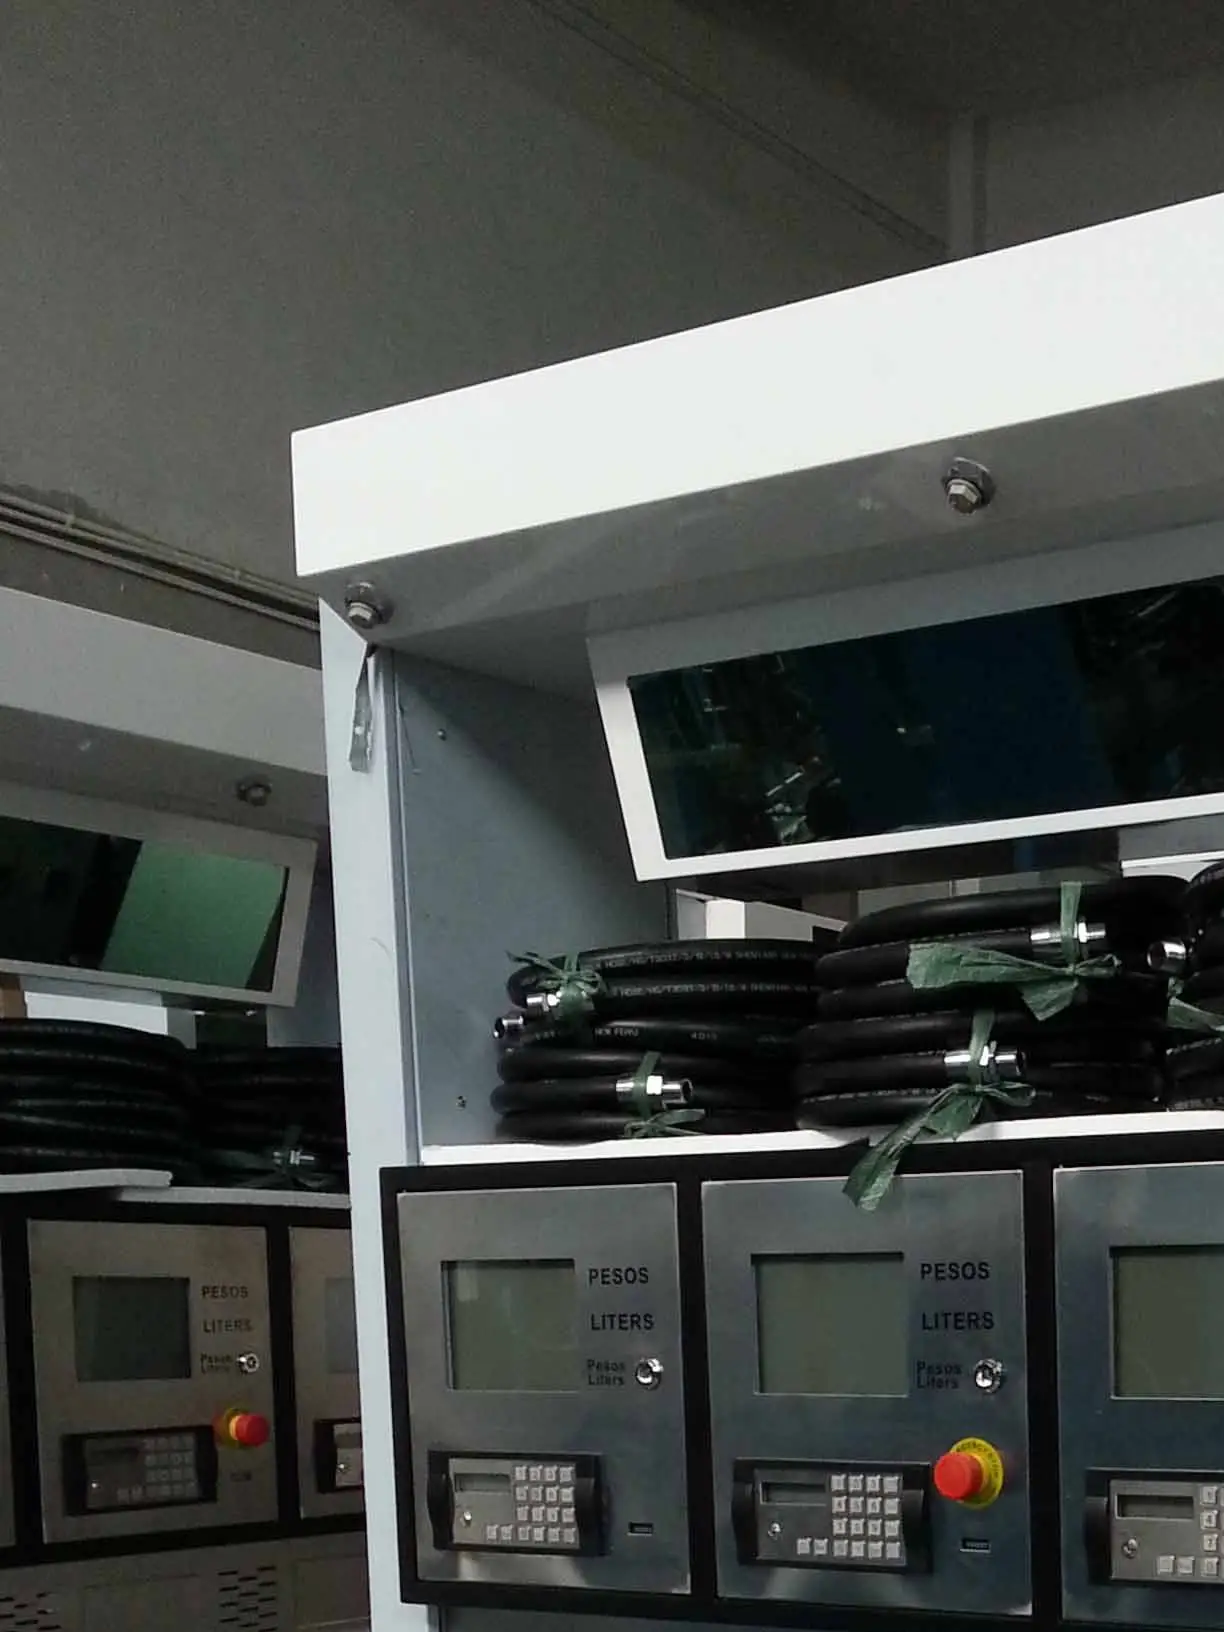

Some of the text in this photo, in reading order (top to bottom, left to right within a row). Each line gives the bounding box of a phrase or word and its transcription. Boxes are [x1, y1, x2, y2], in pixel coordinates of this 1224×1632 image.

[588, 1267, 650, 1286] PESOS
[920, 1262, 991, 1281] PESOS
[201, 1285, 250, 1299] PESOS
[203, 1319, 254, 1333] LITERS
[590, 1313, 655, 1332] LITERS
[921, 1311, 995, 1331] LITERS
[586, 1358, 626, 1373] Pesos
[916, 1360, 963, 1376] Pesos
[587, 1373, 625, 1387] Liters
[916, 1376, 961, 1389] Liters
